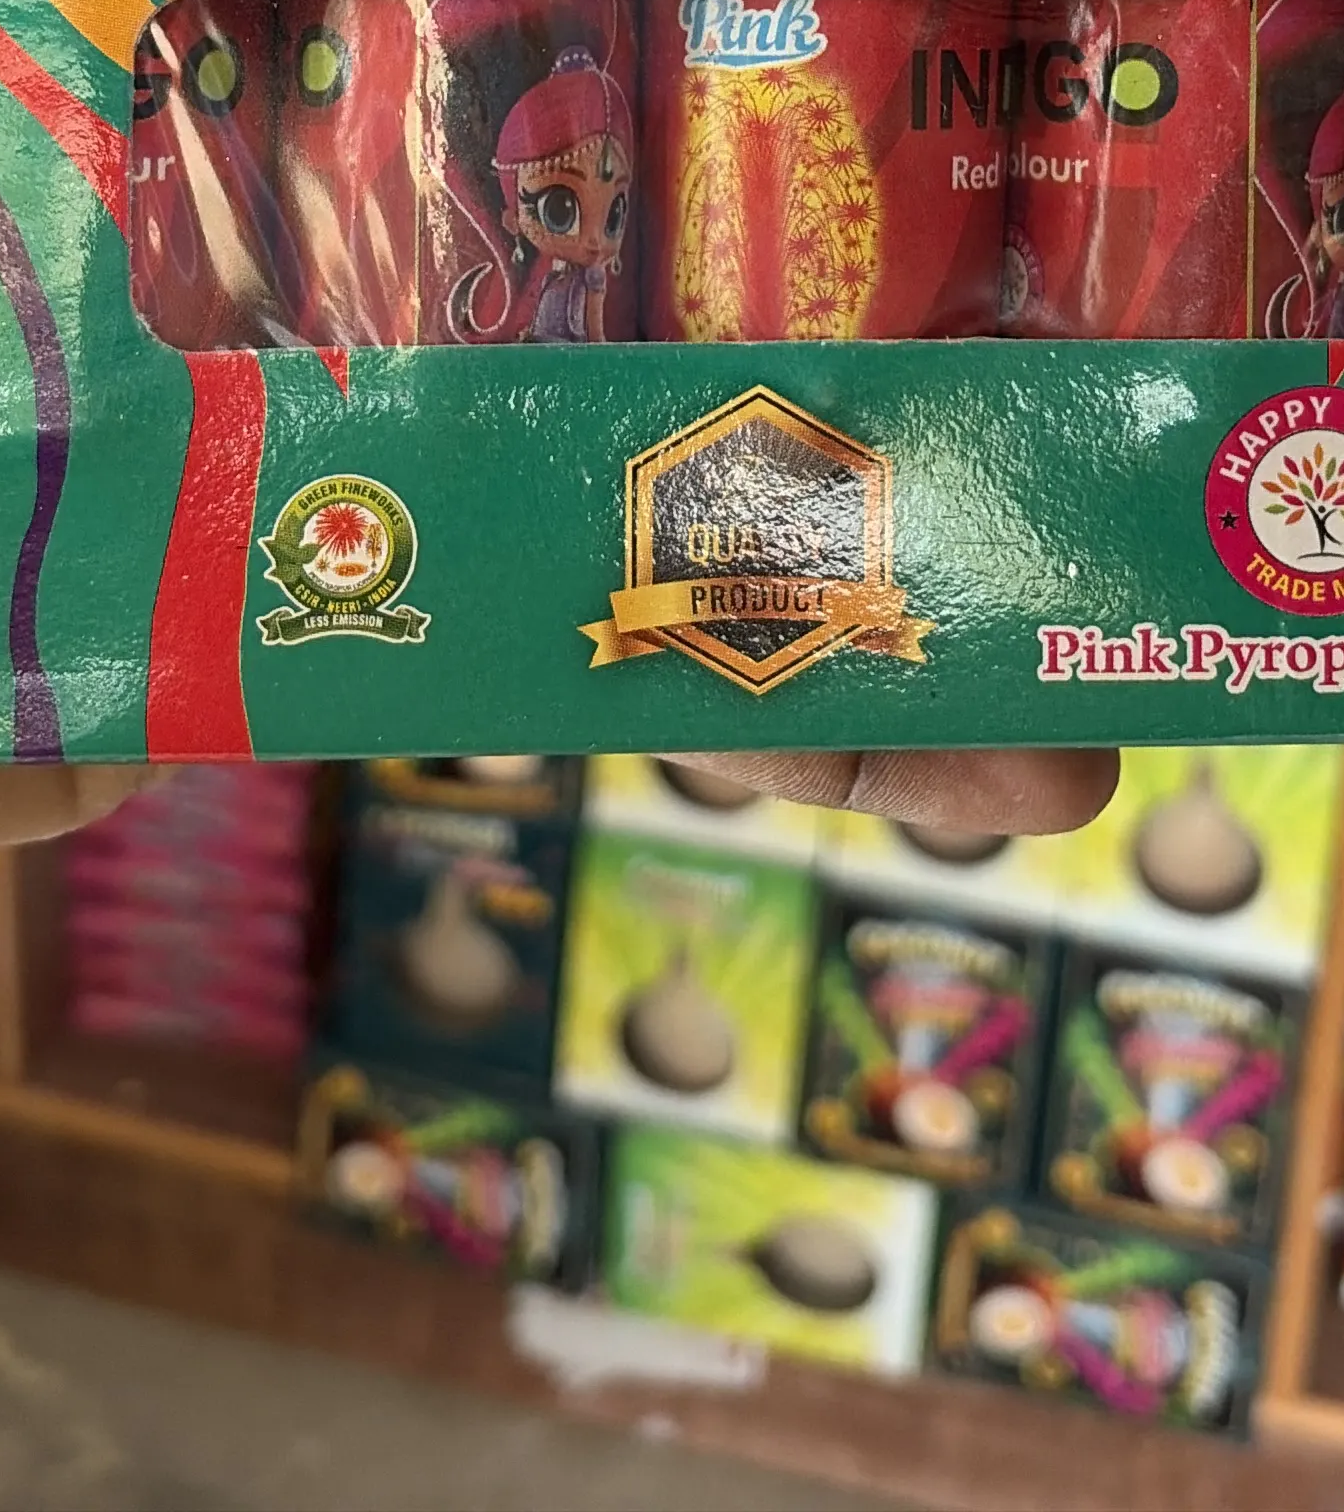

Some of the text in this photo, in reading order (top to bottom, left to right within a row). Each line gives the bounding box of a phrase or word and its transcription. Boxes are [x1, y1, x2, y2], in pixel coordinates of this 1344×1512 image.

[952, 152, 999, 190] Red
[1219, 396, 1332, 483] HAPPY
[298, 482, 404, 526] GREEN FIREWORKS
[690, 583, 824, 615] PRODUCT
[1246, 552, 1325, 602] TRADE
[304, 614, 384, 629] LESS EMISSION
[1040, 627, 1173, 676] Pink
